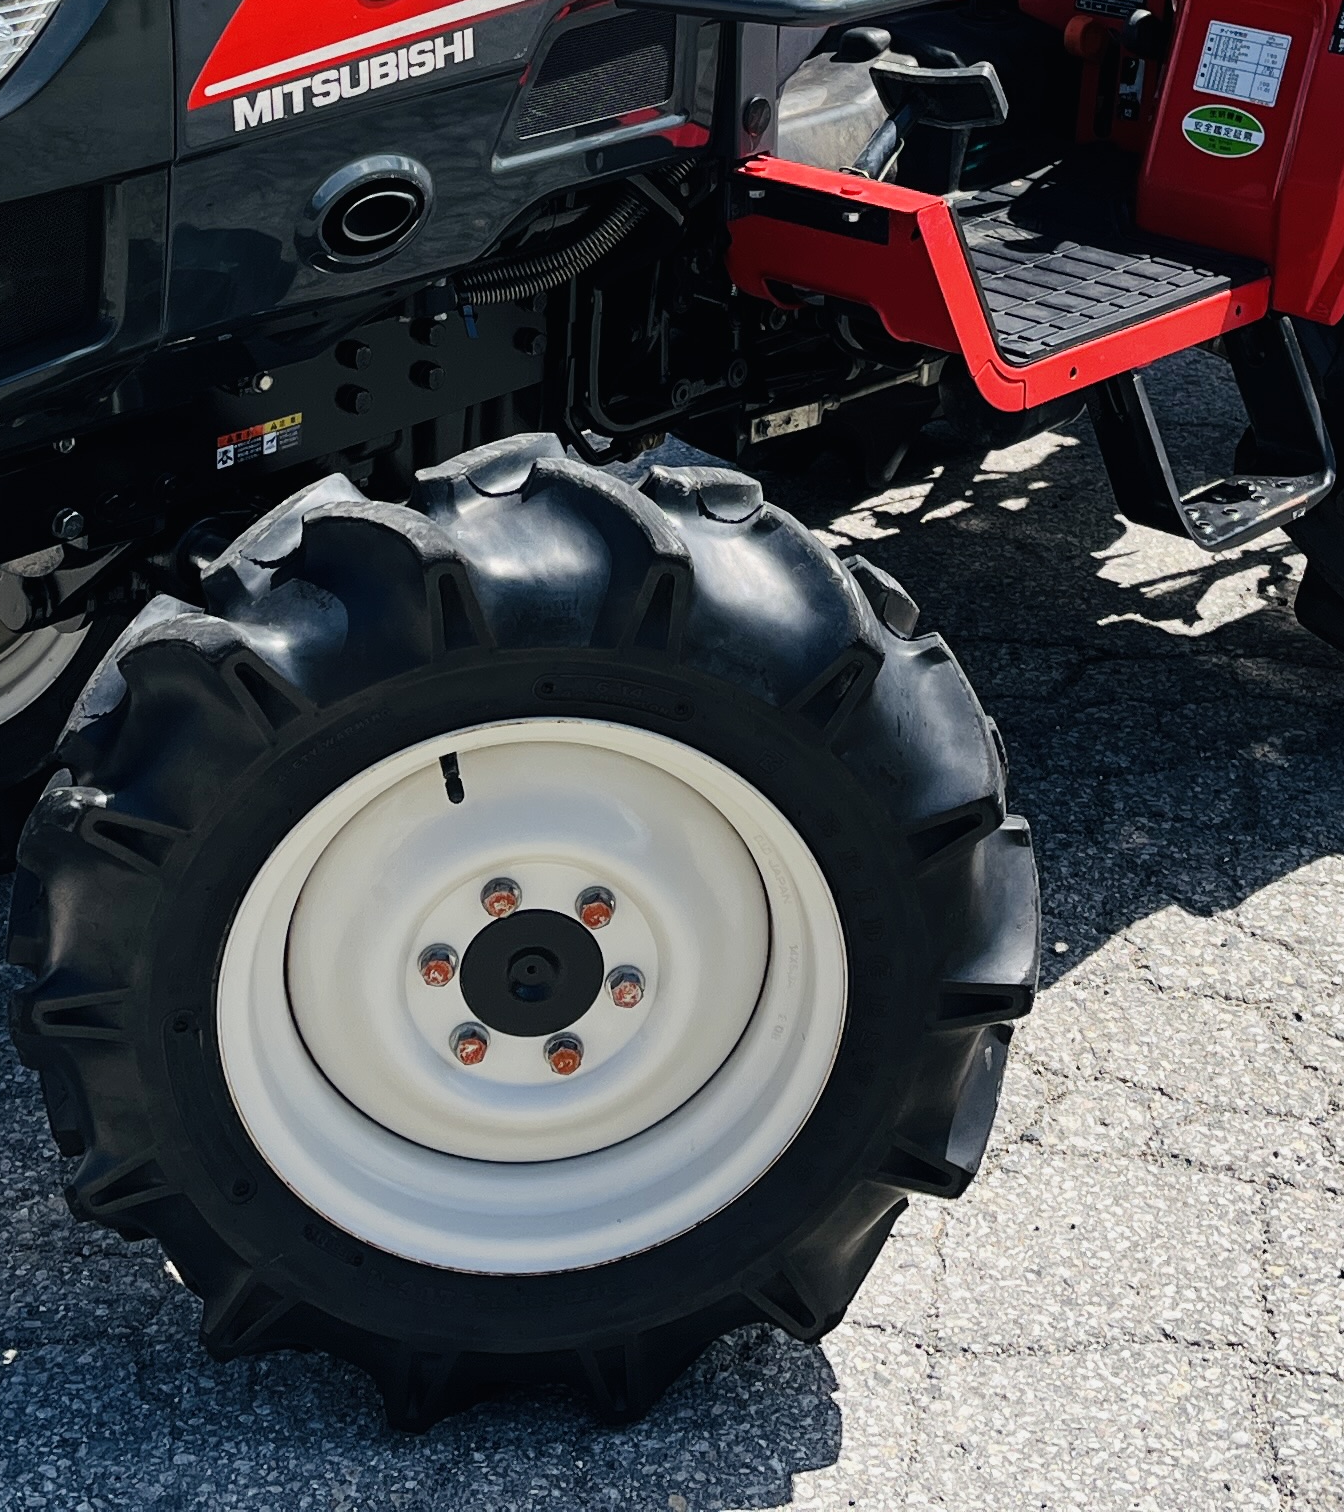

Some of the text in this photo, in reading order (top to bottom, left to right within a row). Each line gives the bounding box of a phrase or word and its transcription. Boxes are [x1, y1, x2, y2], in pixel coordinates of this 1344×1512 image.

[232, 28, 475, 133] MITSUBISHI
[1193, 120, 1254, 142] 安全鑑定証票
